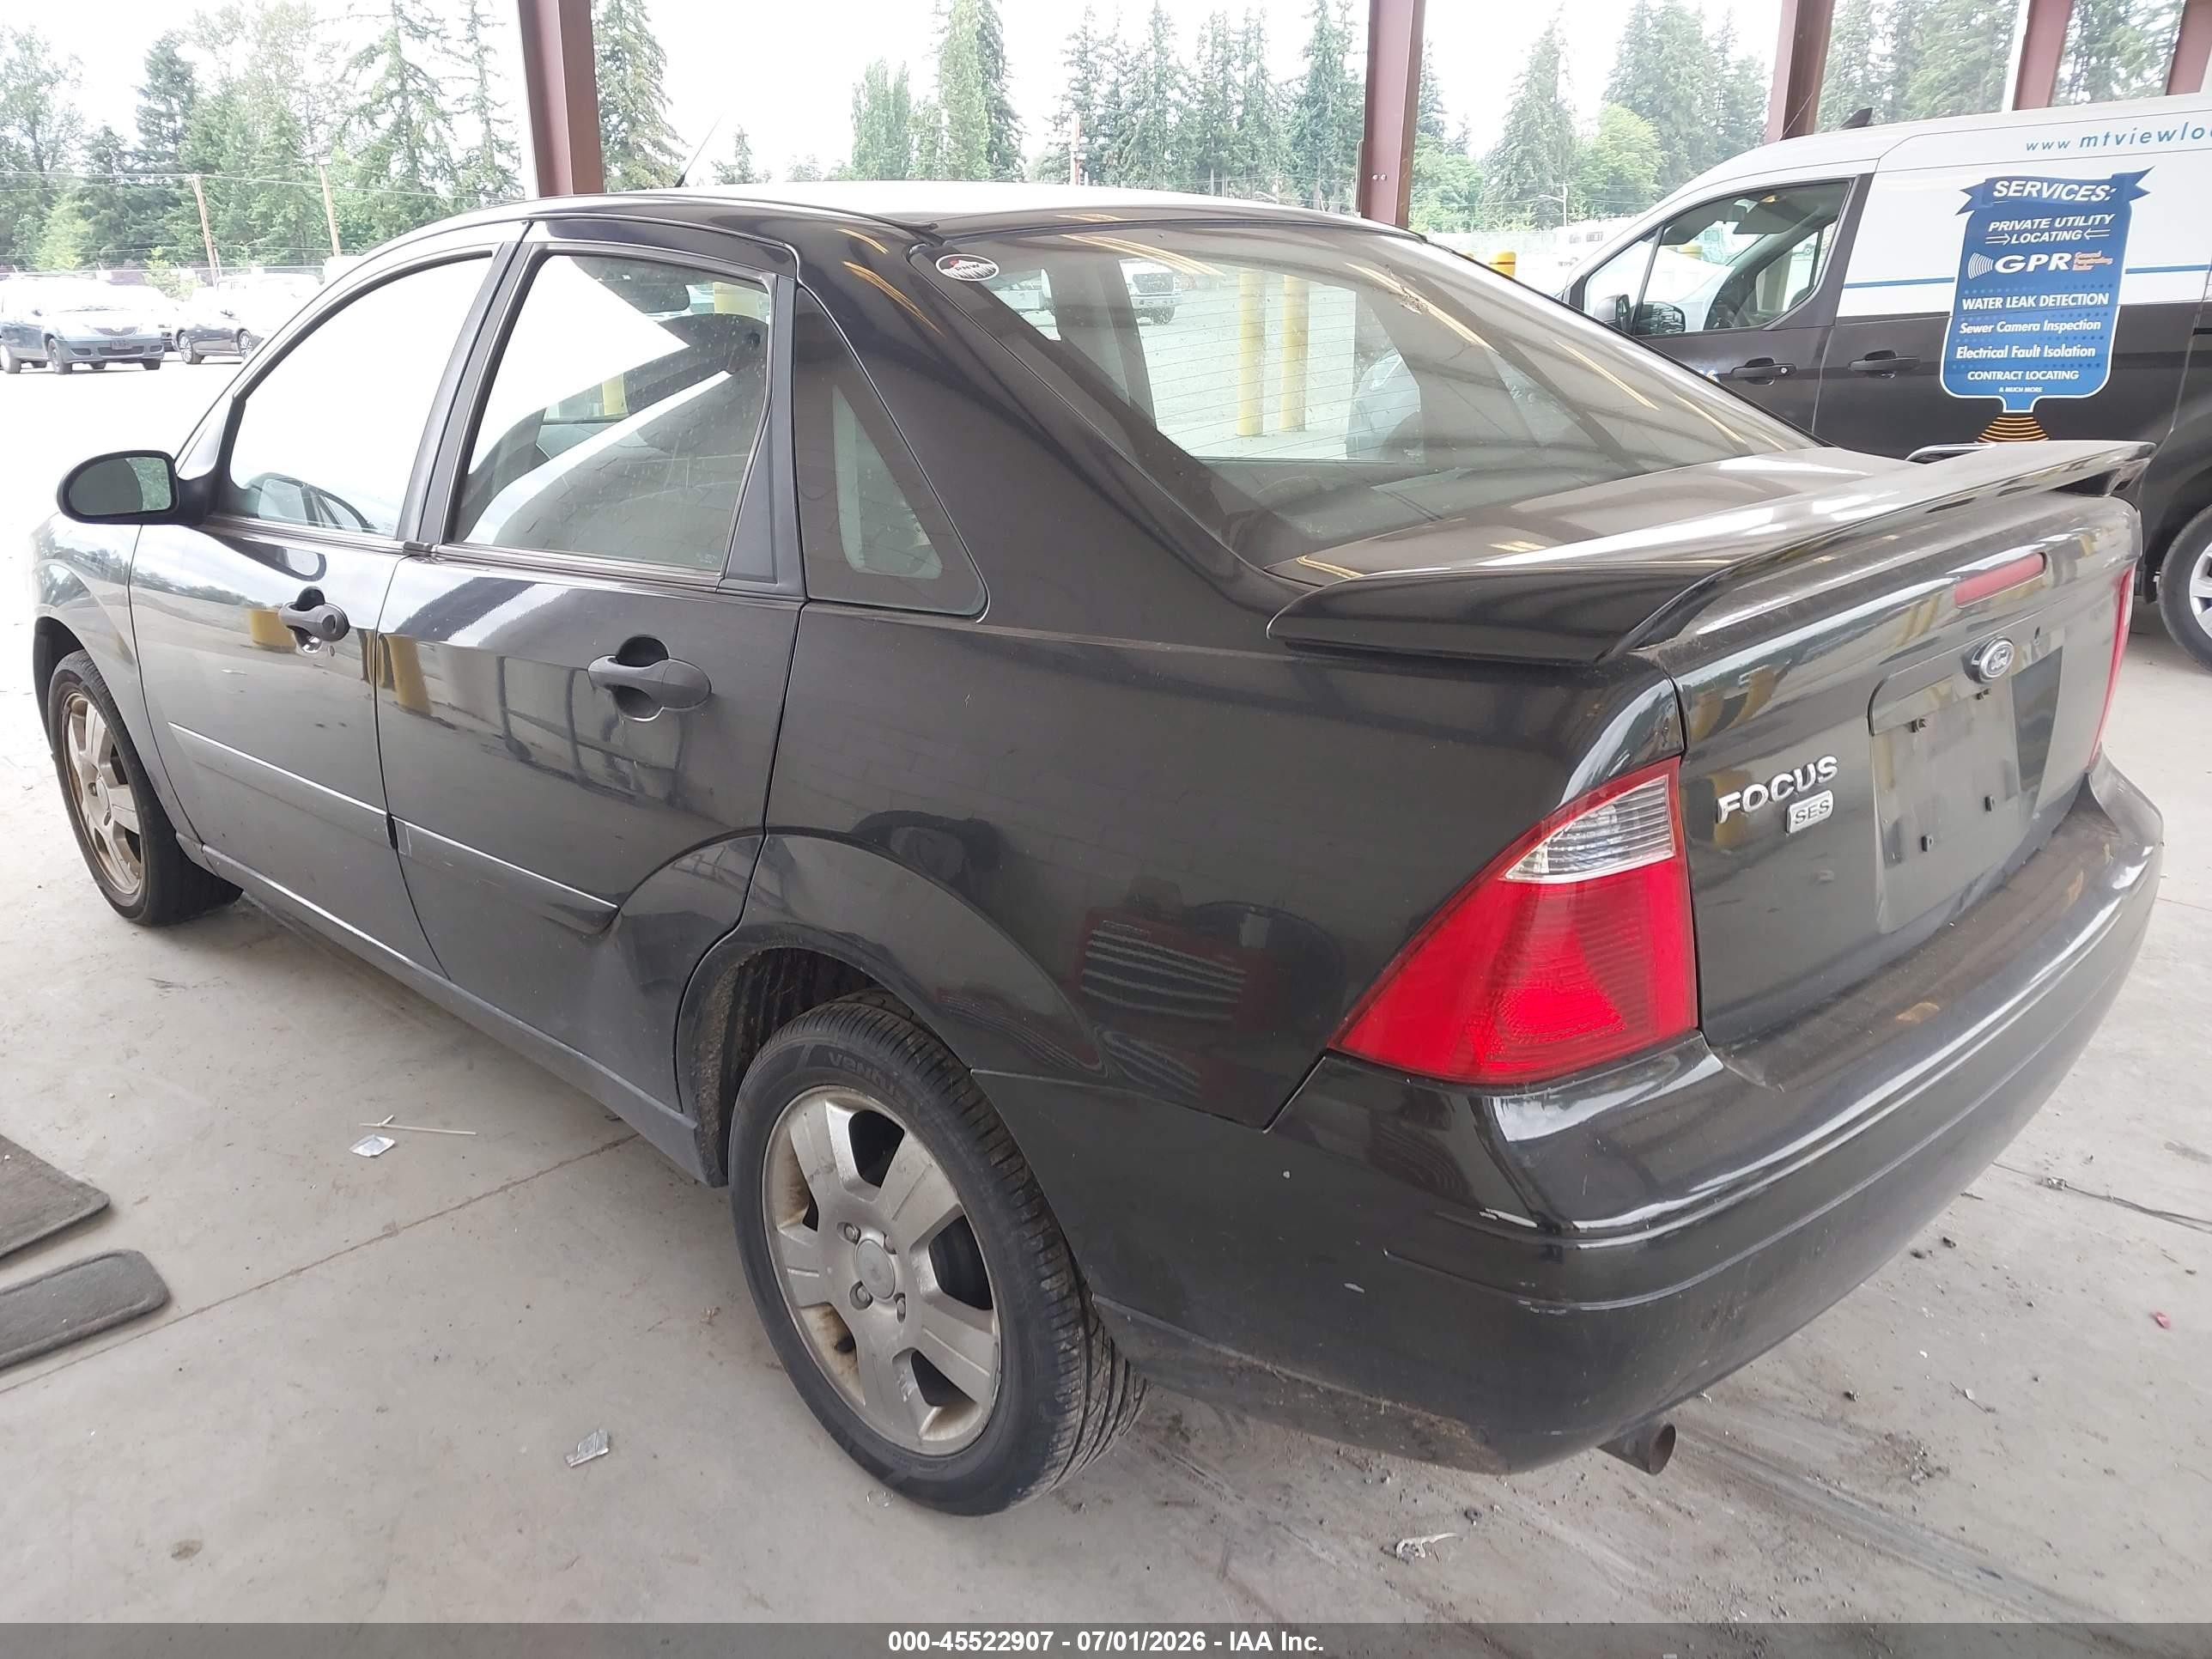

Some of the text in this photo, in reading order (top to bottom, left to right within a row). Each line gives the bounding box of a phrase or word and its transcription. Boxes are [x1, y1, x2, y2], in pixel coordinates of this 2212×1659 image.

[1992, 180, 2118, 202] SERVICES:
[1988, 214, 2116, 233] PRIVATE UTILITY
[2010, 230, 2083, 244] LOCATING
[1994, 252, 2073, 274] GPR
[1961, 293, 2110, 310] WATER LEAK DETECTION
[1959, 319, 2101, 334] Sewer Camera Inspection
[1956, 343, 2096, 359] Electrical Fault Isolation
[1967, 370, 2080, 380] CONTRACT LOCATING
[1717, 755, 1838, 824] FOCUS
[1795, 799, 1830, 824] SES
